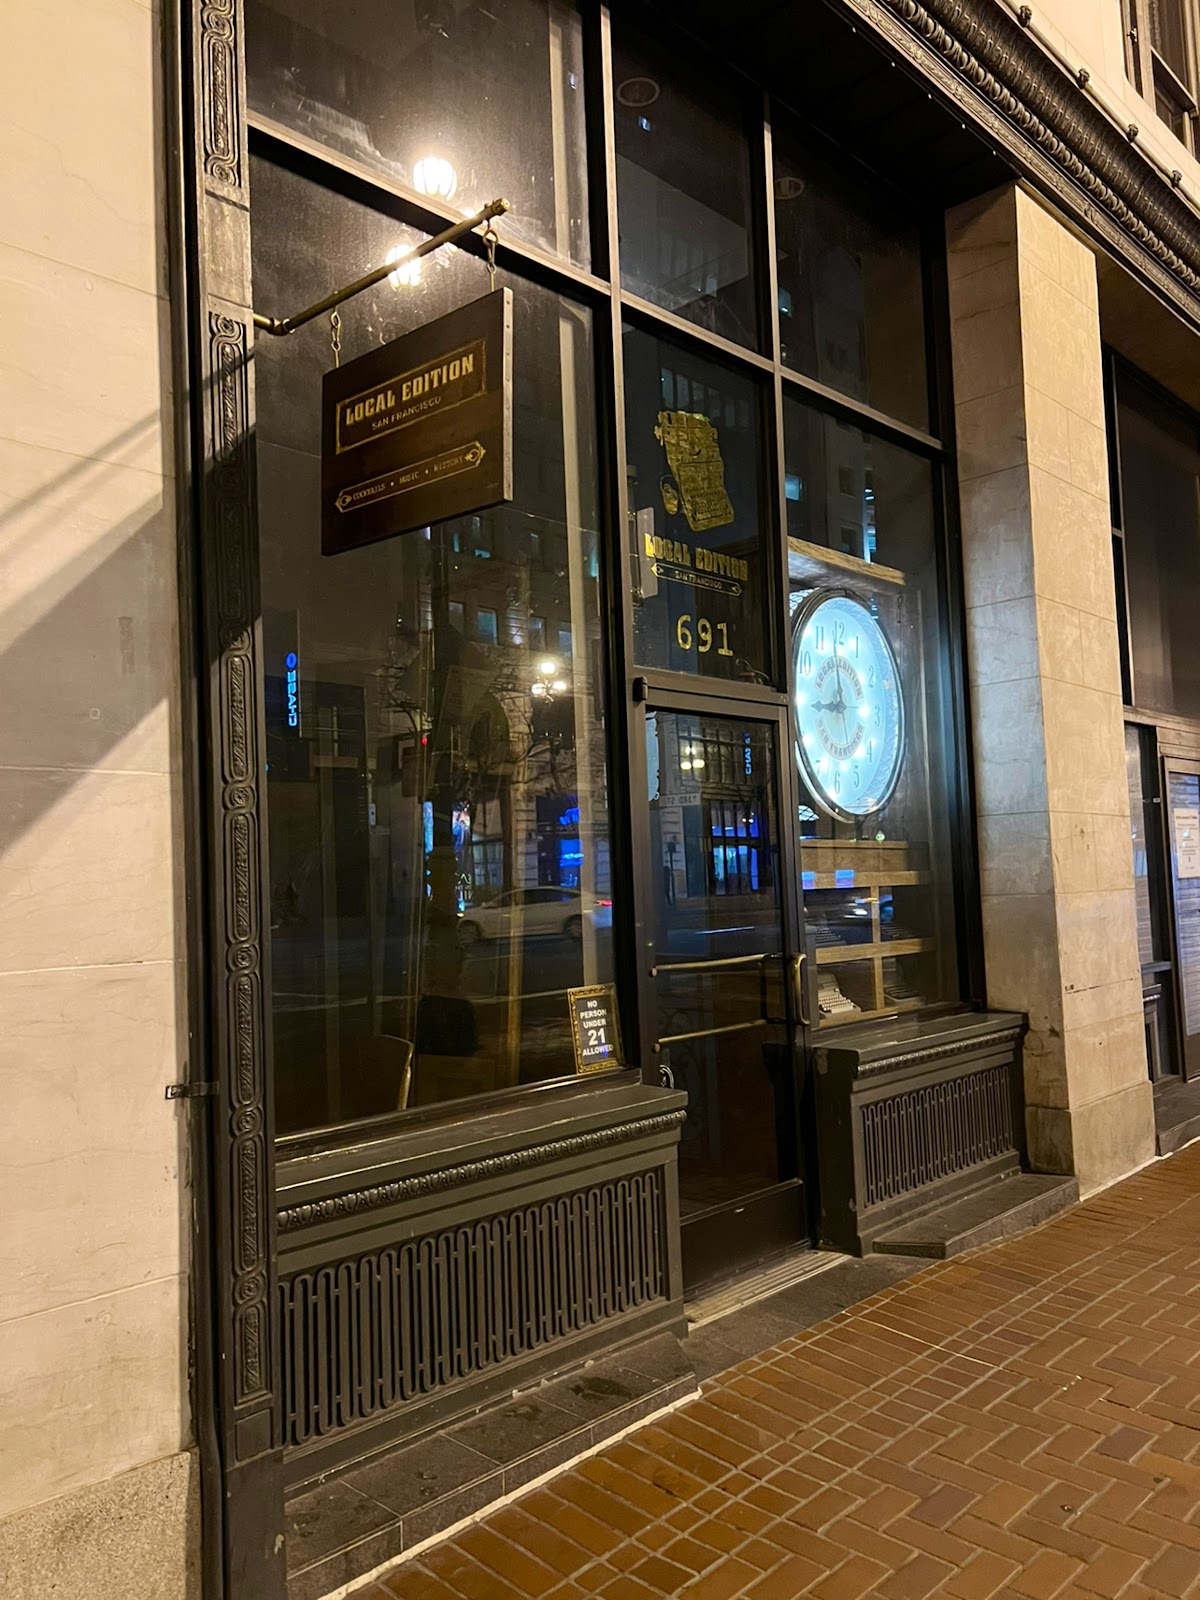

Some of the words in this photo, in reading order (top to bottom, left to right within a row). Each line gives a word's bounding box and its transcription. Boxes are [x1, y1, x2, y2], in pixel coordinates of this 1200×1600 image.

[346, 390, 396, 425] LOCAL
[402, 353, 474, 401] EDITION
[372, 416, 389, 430] SAN
[391, 396, 442, 423] FRANCISCO
[352, 483, 386, 501] COCKTAILS
[399, 472, 420, 484] MUSIC
[434, 456, 465, 472] HISTORY
[644, 533, 691, 566] LOCAL
[695, 547, 748, 581] EDITION
[689, 574, 723, 589] FRANCISCO
[676, 614, 734, 657] 691
[815, 625, 824, 650] 11
[832, 620, 845, 646] 12
[800, 650, 811, 676] 10
[816, 657, 836, 688] LOCAL
[838, 658, 861, 697] EDITION
[868, 664, 875, 688] 2
[874, 705, 881, 728] 3
[817, 718, 829, 744] SAN
[830, 725, 864, 757] FRANCISCO
[866, 739, 873, 763] 4
[834, 770, 840, 795] 6
[853, 764, 860, 788] 5
[580, 1008, 607, 1019] PERSON
[587, 1000, 598, 1008] NO
[583, 1018, 607, 1029] UNDER
[587, 1027, 606, 1046] 21
[582, 1044, 614, 1056] ALLOWED
